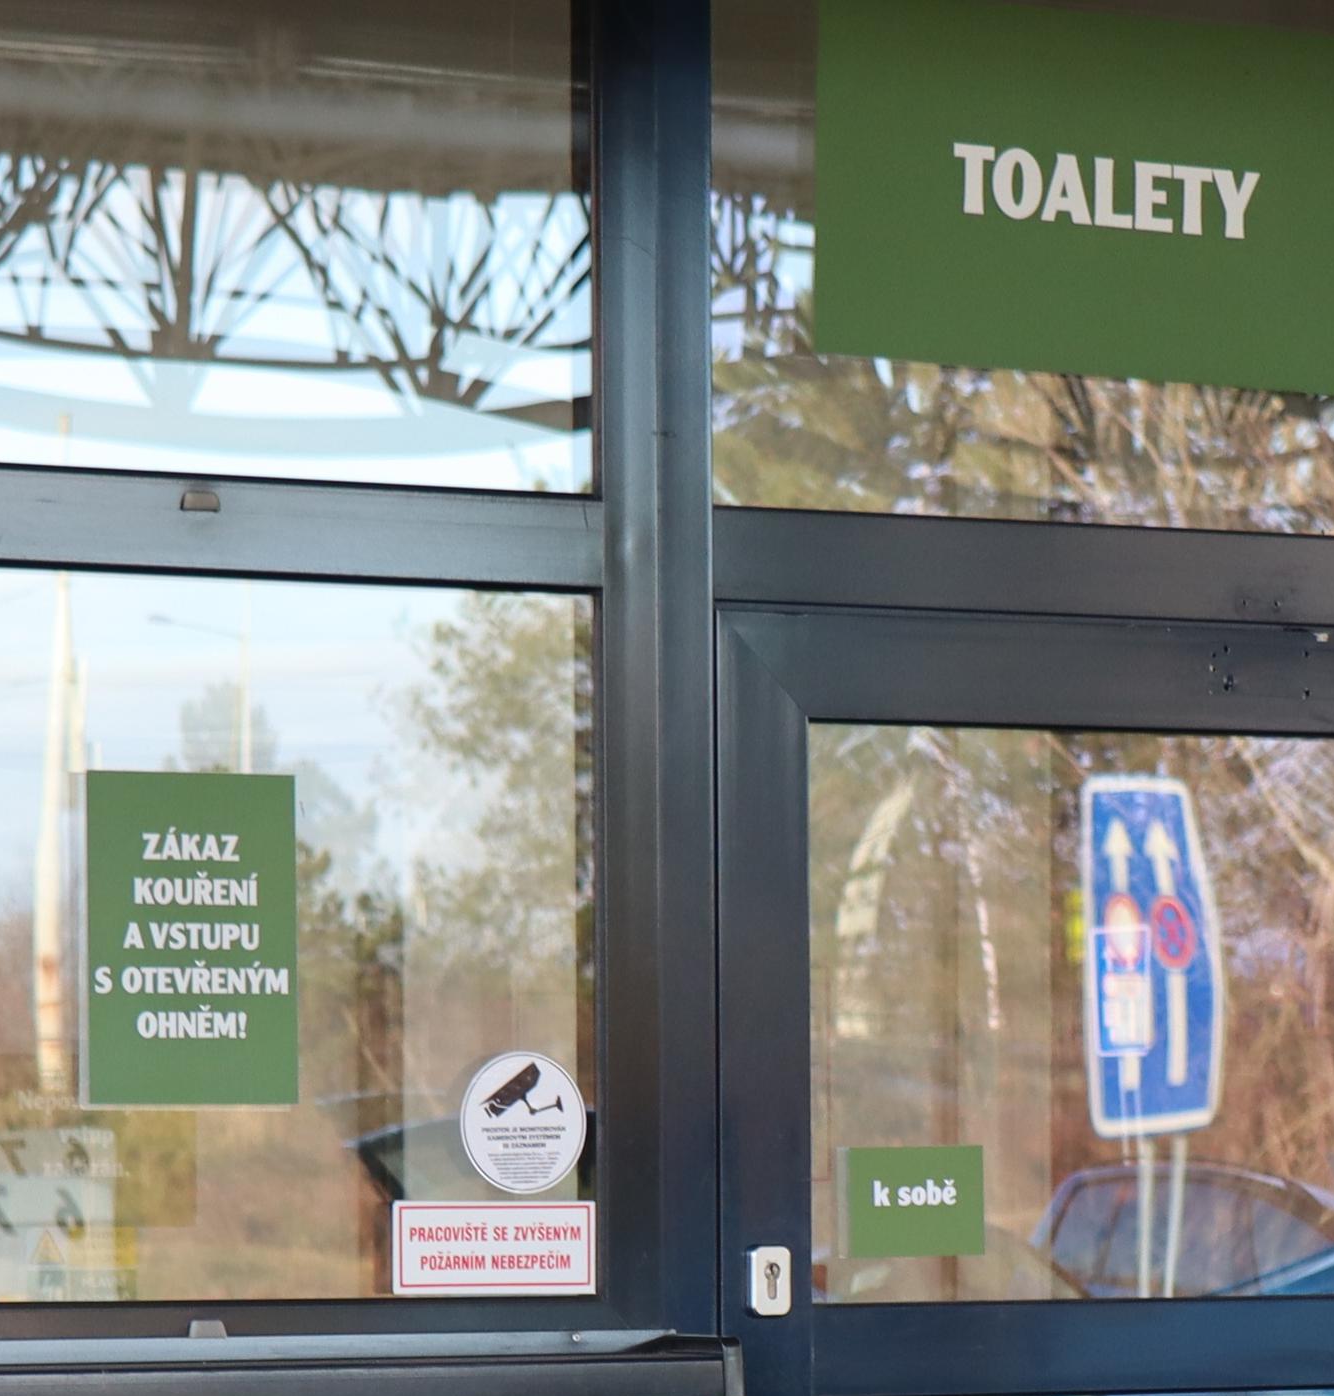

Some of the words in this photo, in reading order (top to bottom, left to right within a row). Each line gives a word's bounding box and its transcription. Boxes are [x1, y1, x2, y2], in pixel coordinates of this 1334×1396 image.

[953, 142, 1261, 240] TOALETY
[142, 826, 241, 862] ZÁKAZ
[133, 871, 259, 907] KOUŘENÍ
[123, 922, 145, 949] A
[149, 922, 260, 951] VSTUPU
[94, 966, 113, 995] S
[121, 960, 289, 995] OTEVŘENÝM
[136, 1004, 248, 1039] OHNĚM!
[873, 1180, 891, 1206] k
[897, 1178, 957, 1206] sobě
[409, 1222, 488, 1242] PRACOVIŠTĚ
[493, 1226, 509, 1242] SE
[514, 1221, 582, 1242] ZVÝŠENÝM
[420, 1251, 486, 1271] POŽÁRNÍM
[491, 1250, 572, 1270] NEBEZPEČÍM
